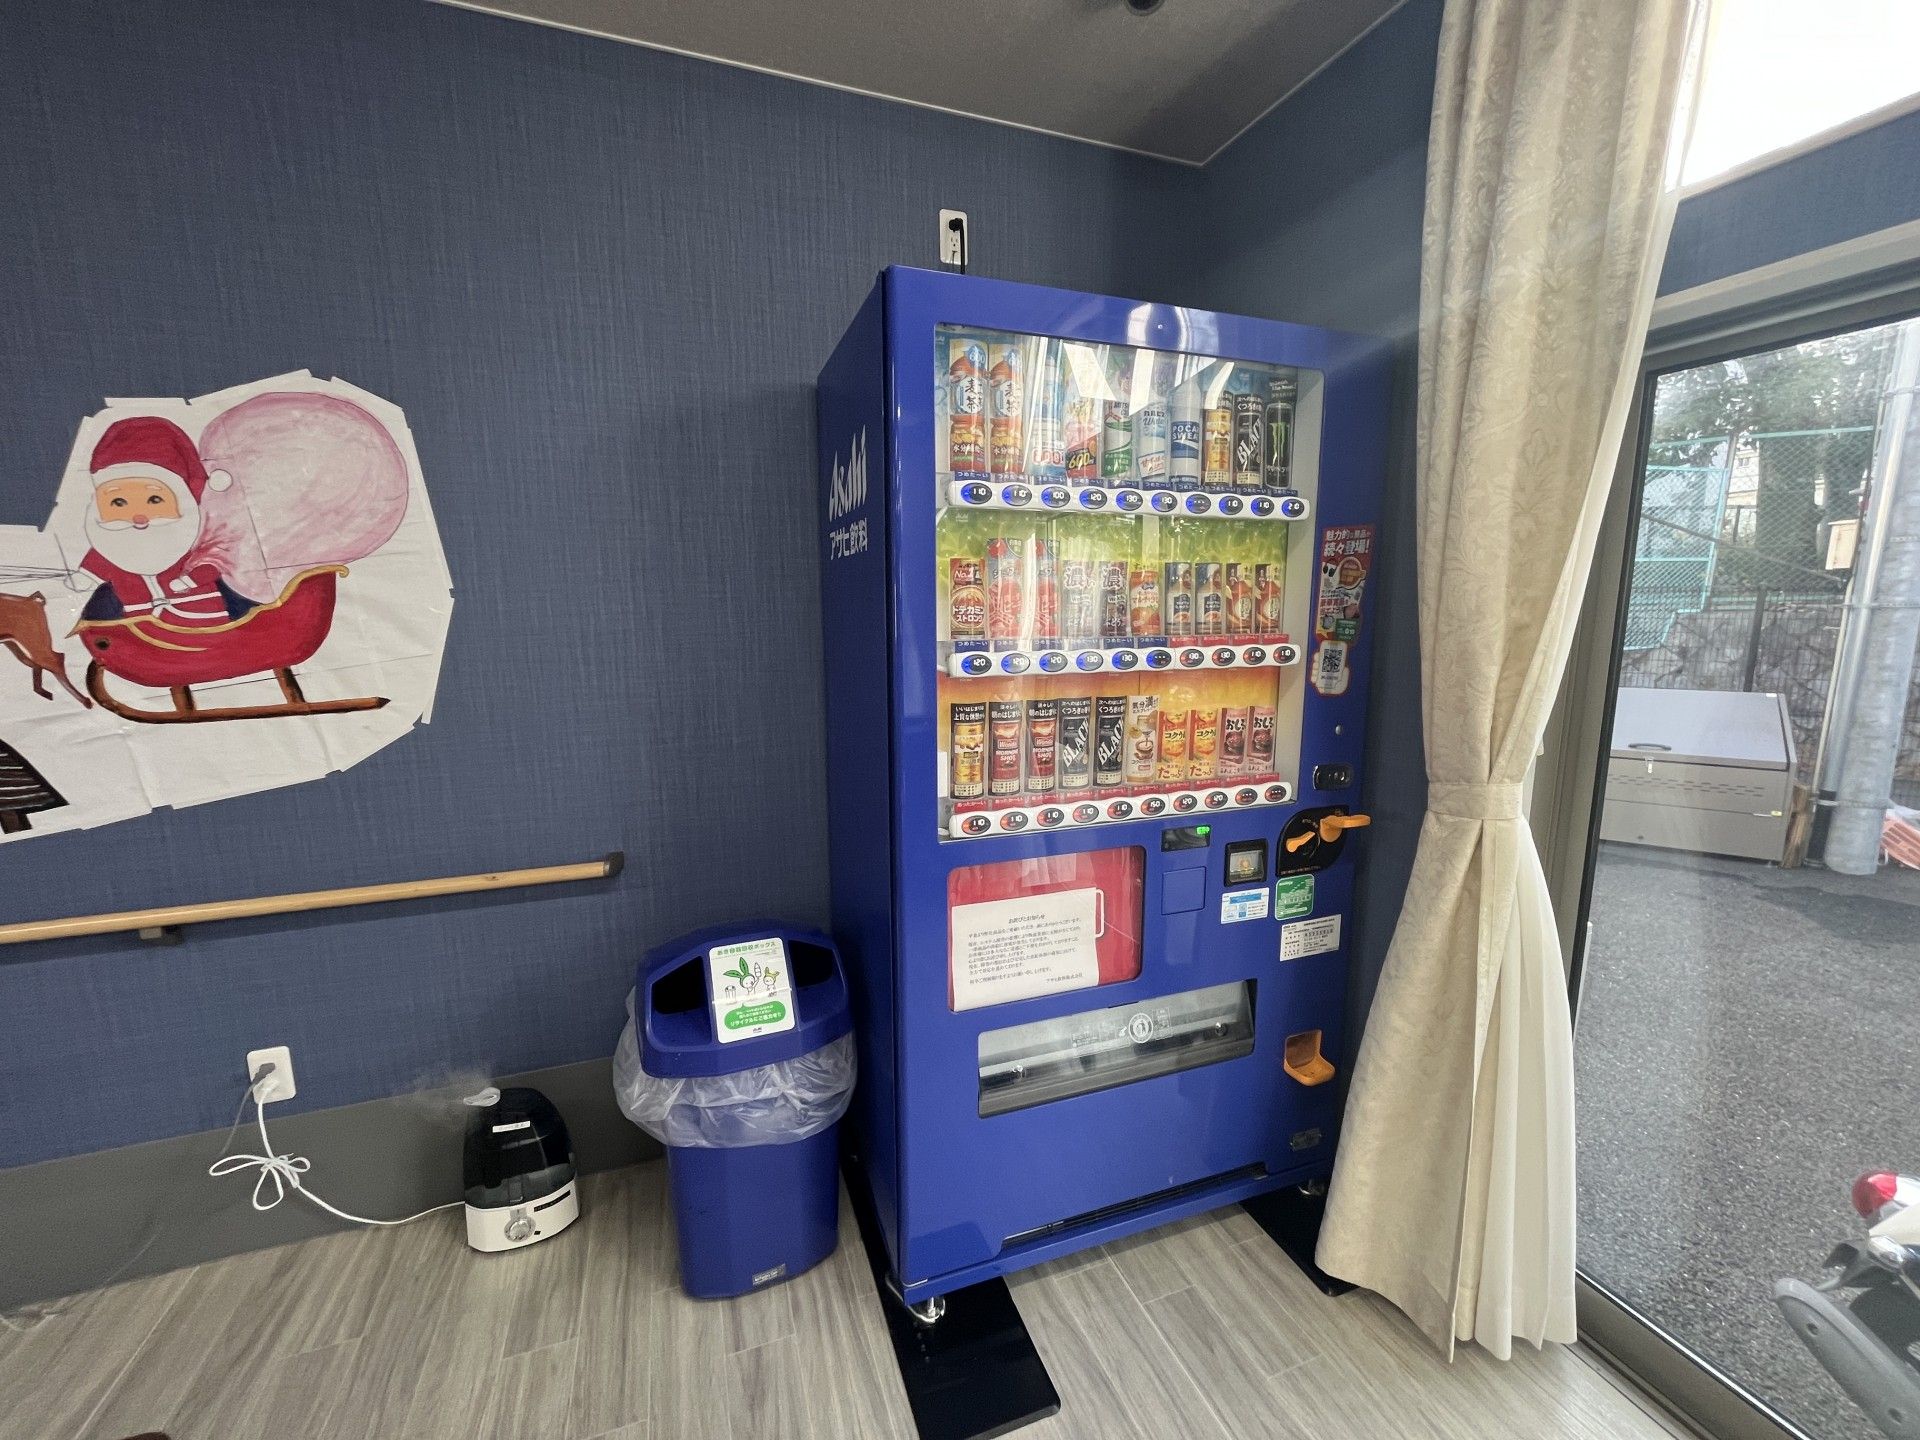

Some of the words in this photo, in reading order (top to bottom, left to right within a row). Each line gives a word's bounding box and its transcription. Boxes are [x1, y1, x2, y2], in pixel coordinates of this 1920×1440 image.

[829, 424, 867, 522] Asahi
[1069, 452, 1091, 470] 600
[829, 517, 868, 561] アサヒ飲料
